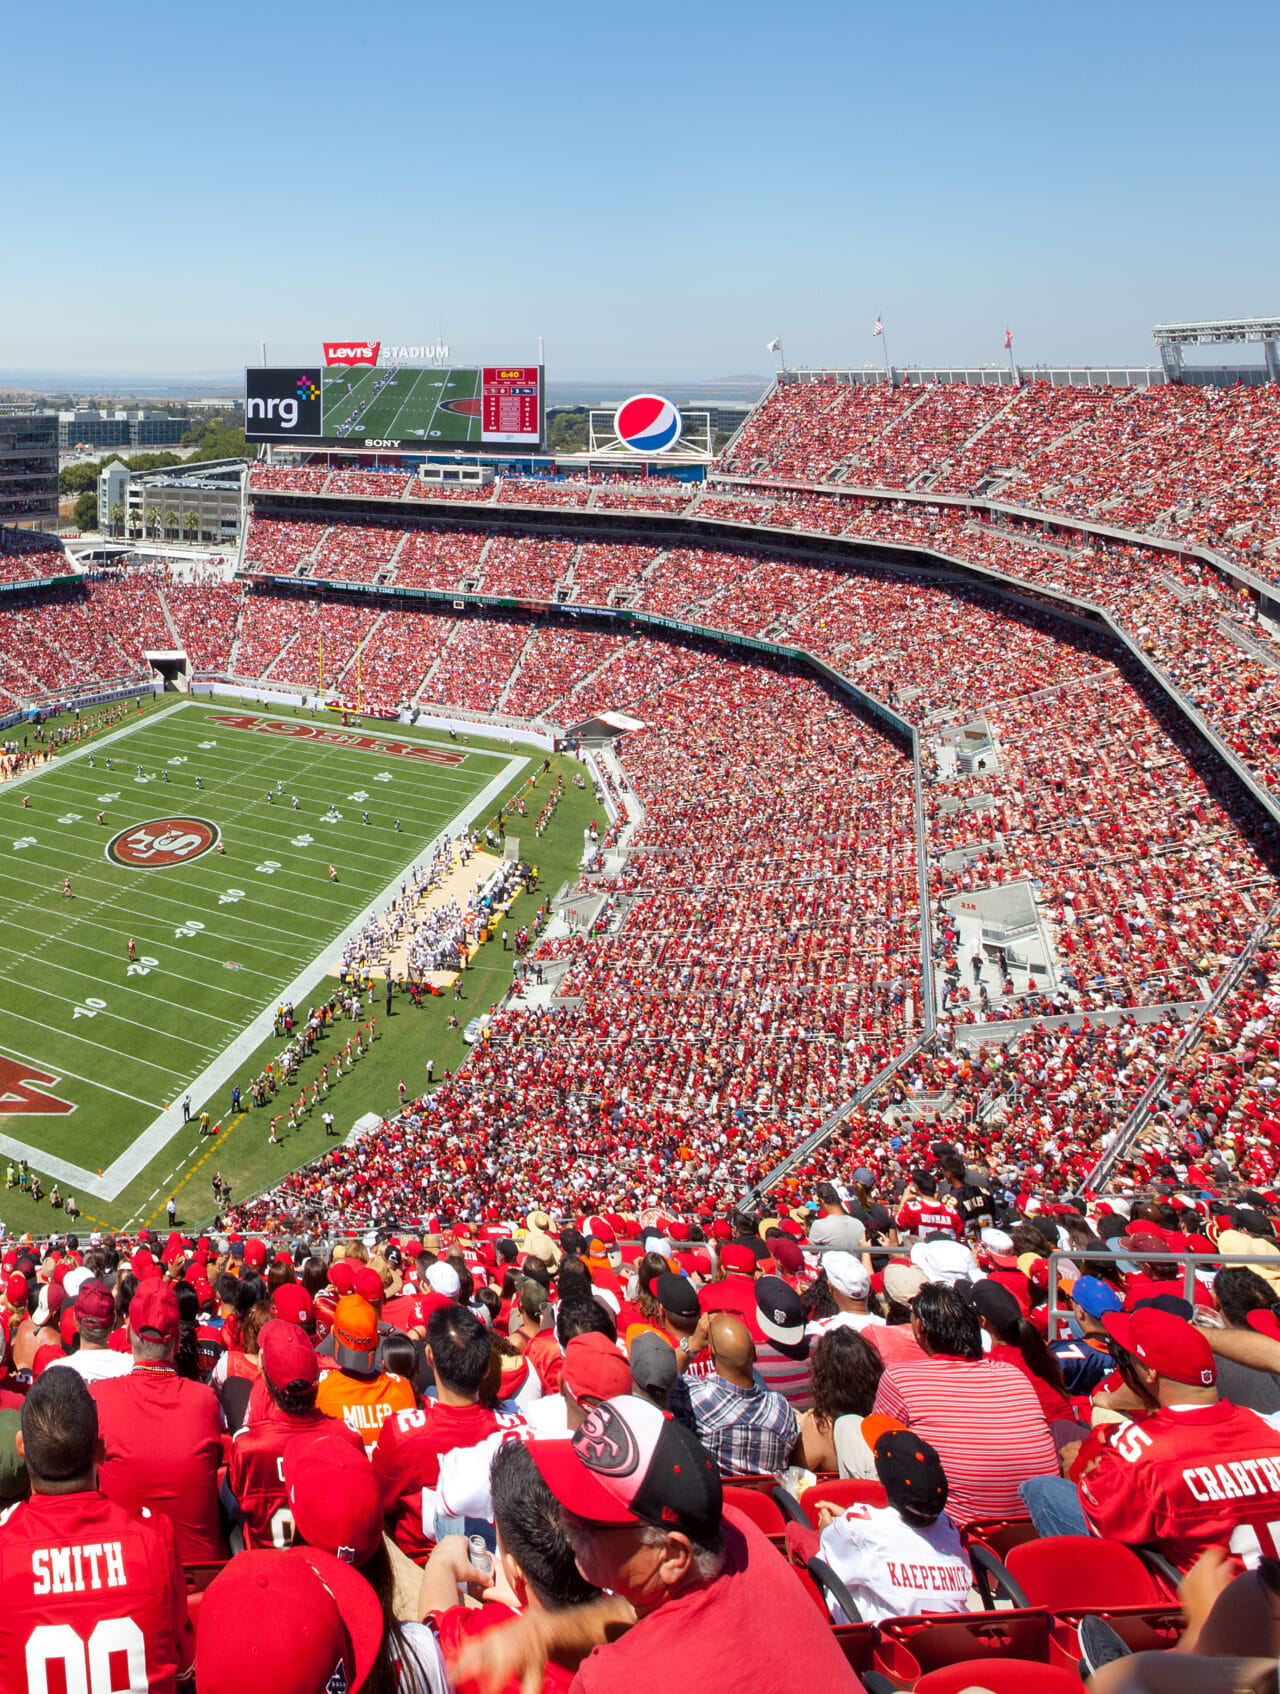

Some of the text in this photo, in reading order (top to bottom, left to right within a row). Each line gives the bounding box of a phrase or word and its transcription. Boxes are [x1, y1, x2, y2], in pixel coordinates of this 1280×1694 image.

[328, 346, 450, 358] LEVI'S STADIUM
[247, 398, 298, 429] nrg
[365, 439, 402, 448] SONY
[205, 715, 470, 767] 49ERS
[255, 861, 282, 874] 50
[218, 889, 246, 904] 40
[175, 921, 205, 938] 30
[127, 957, 159, 976] 20
[73, 998, 107, 1019] 10
[343, 1403, 393, 1430] MILLER
[32, 1542, 127, 1595] SMITH
[886, 1562, 970, 1592] KAEPERNICK
